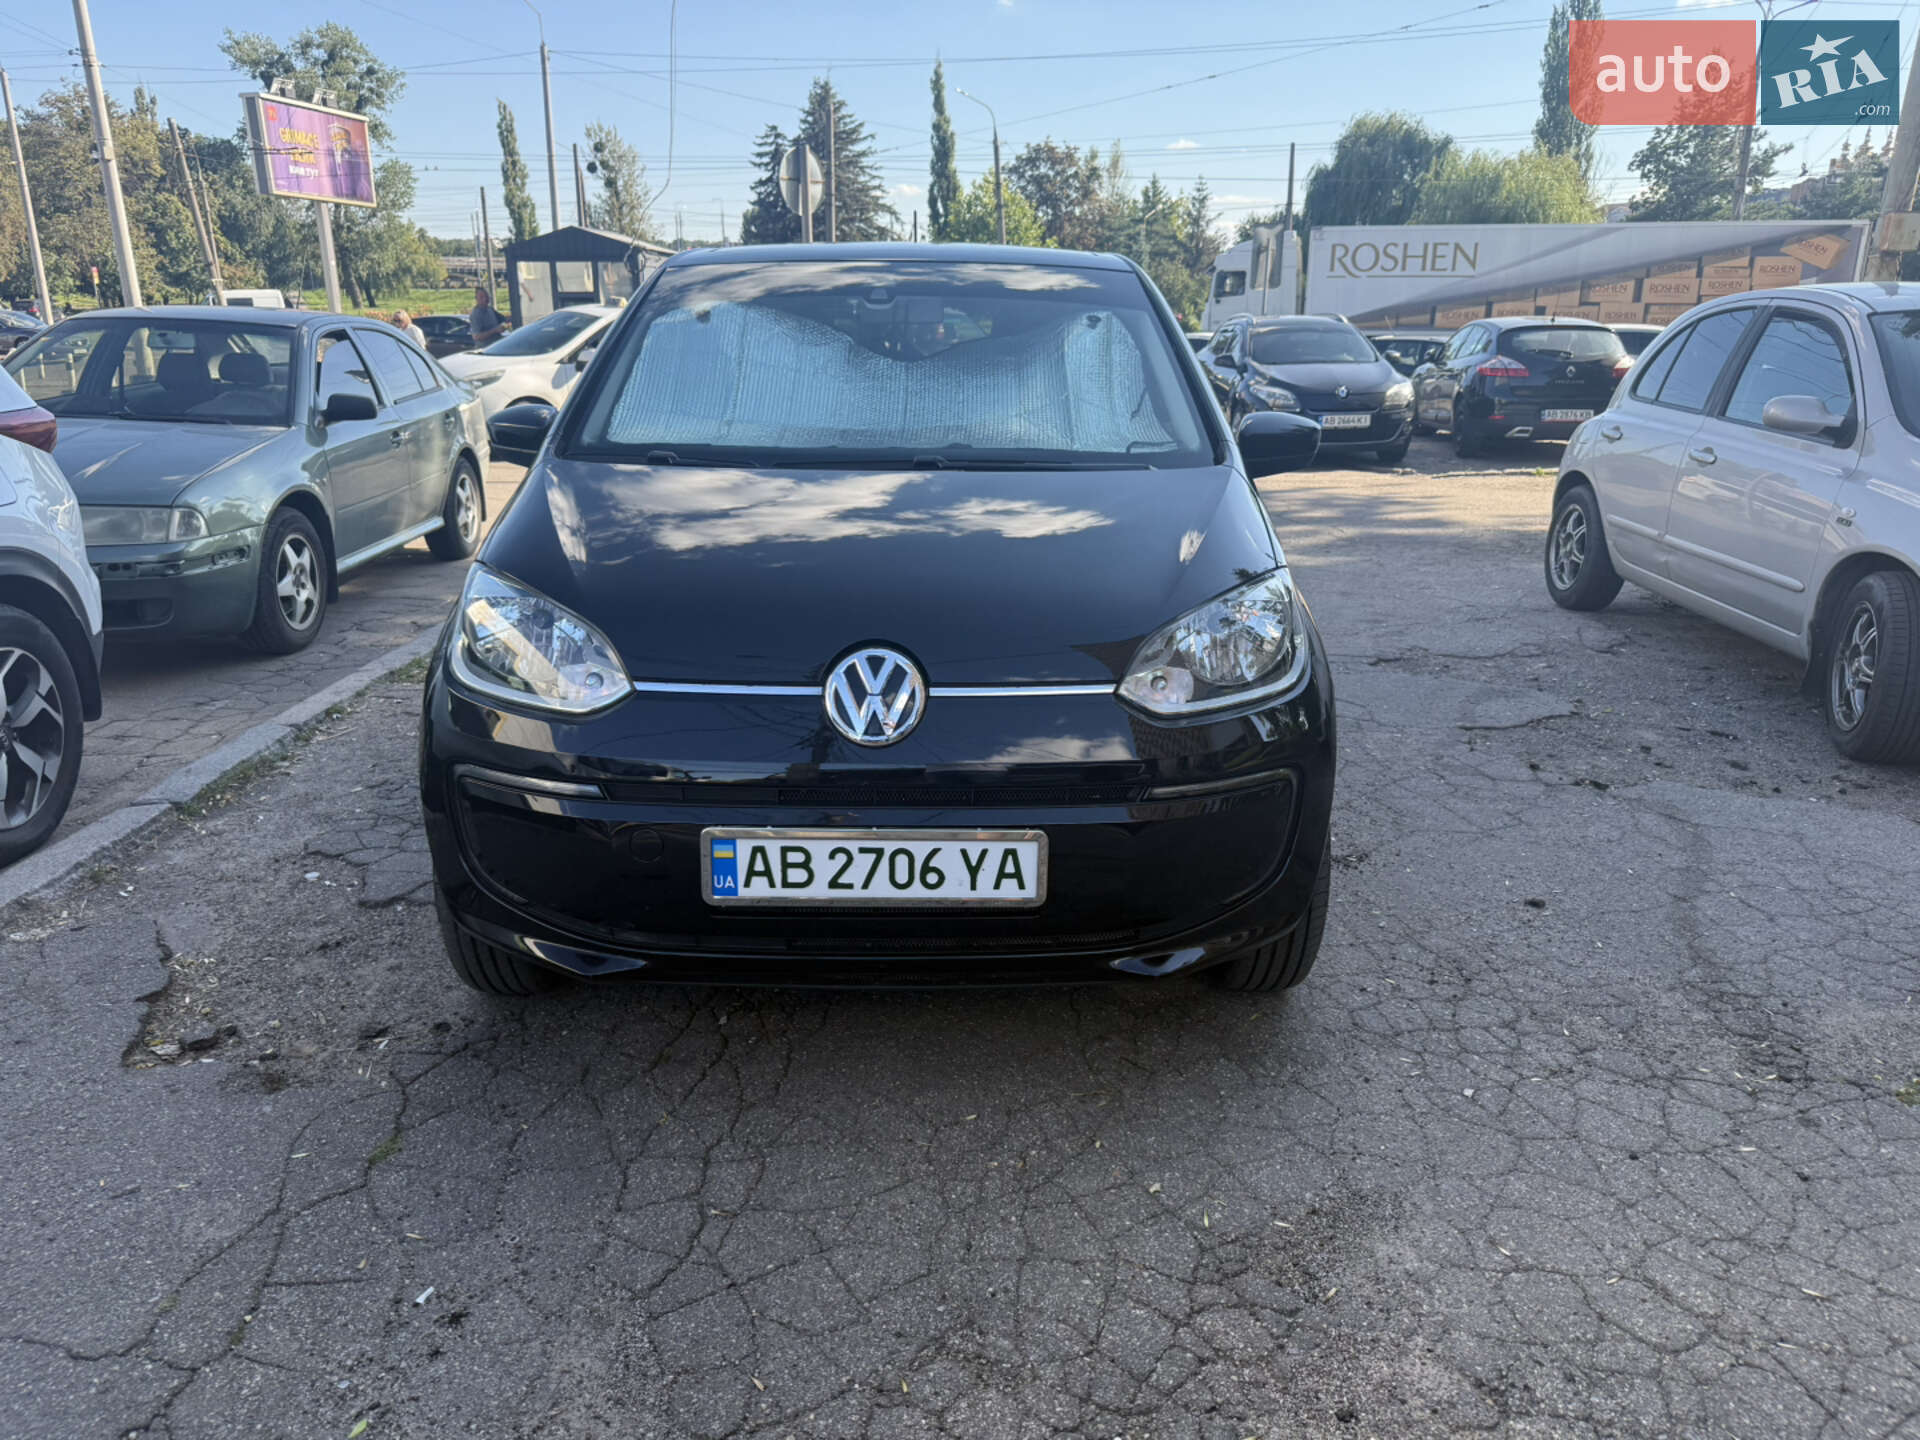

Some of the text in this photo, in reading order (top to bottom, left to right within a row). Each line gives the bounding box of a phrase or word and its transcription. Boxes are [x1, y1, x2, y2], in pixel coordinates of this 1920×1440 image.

[1328, 242, 1479, 278] ROSHEN
[713, 874, 736, 889] UA
[743, 845, 1026, 891] AB 2706 YA
